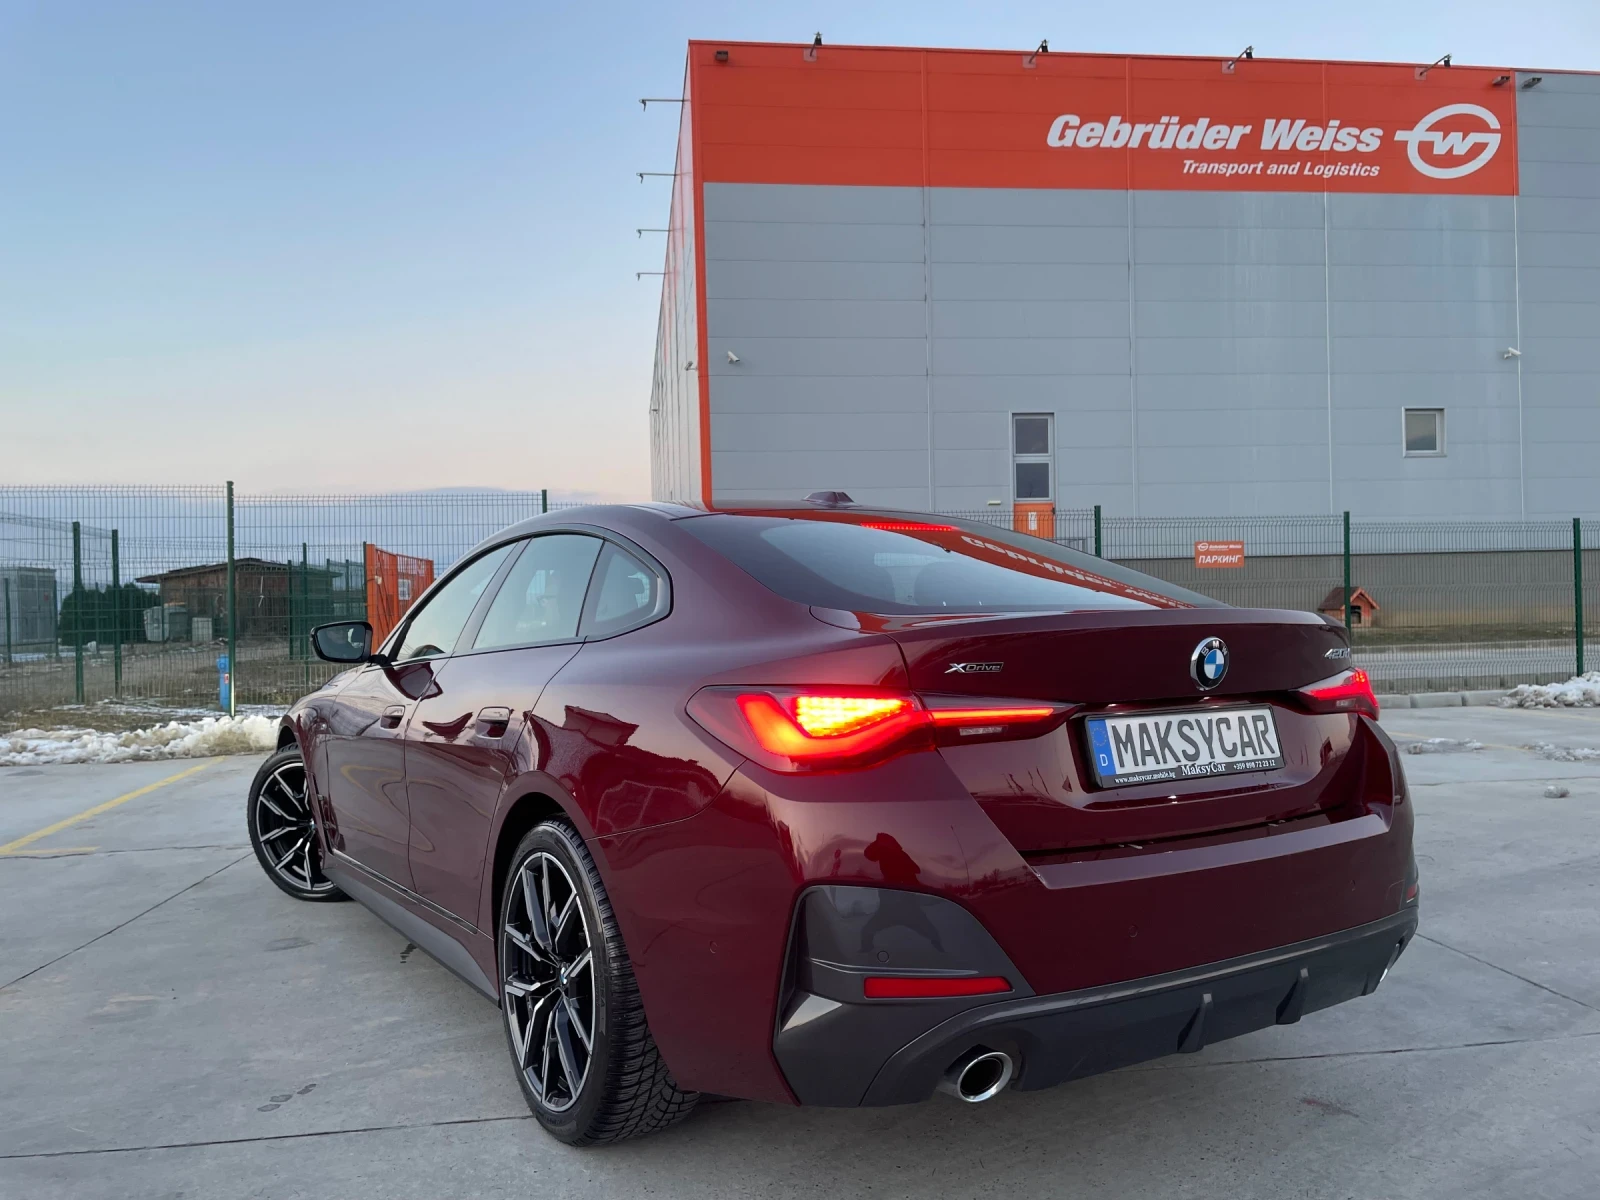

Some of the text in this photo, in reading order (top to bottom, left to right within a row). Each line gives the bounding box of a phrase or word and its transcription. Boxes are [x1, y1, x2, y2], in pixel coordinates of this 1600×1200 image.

[1046, 114, 1384, 153] Gebrüder Weiss
[1183, 159, 1381, 178] Transport and Logistics
[1198, 554, 1242, 564] ПАРКИНГ
[1200, 640, 1228, 657] BMW
[1111, 714, 1276, 768] MAKSYCAR
[1099, 754, 1109, 767] D
[1181, 761, 1226, 776] MaksyCar
